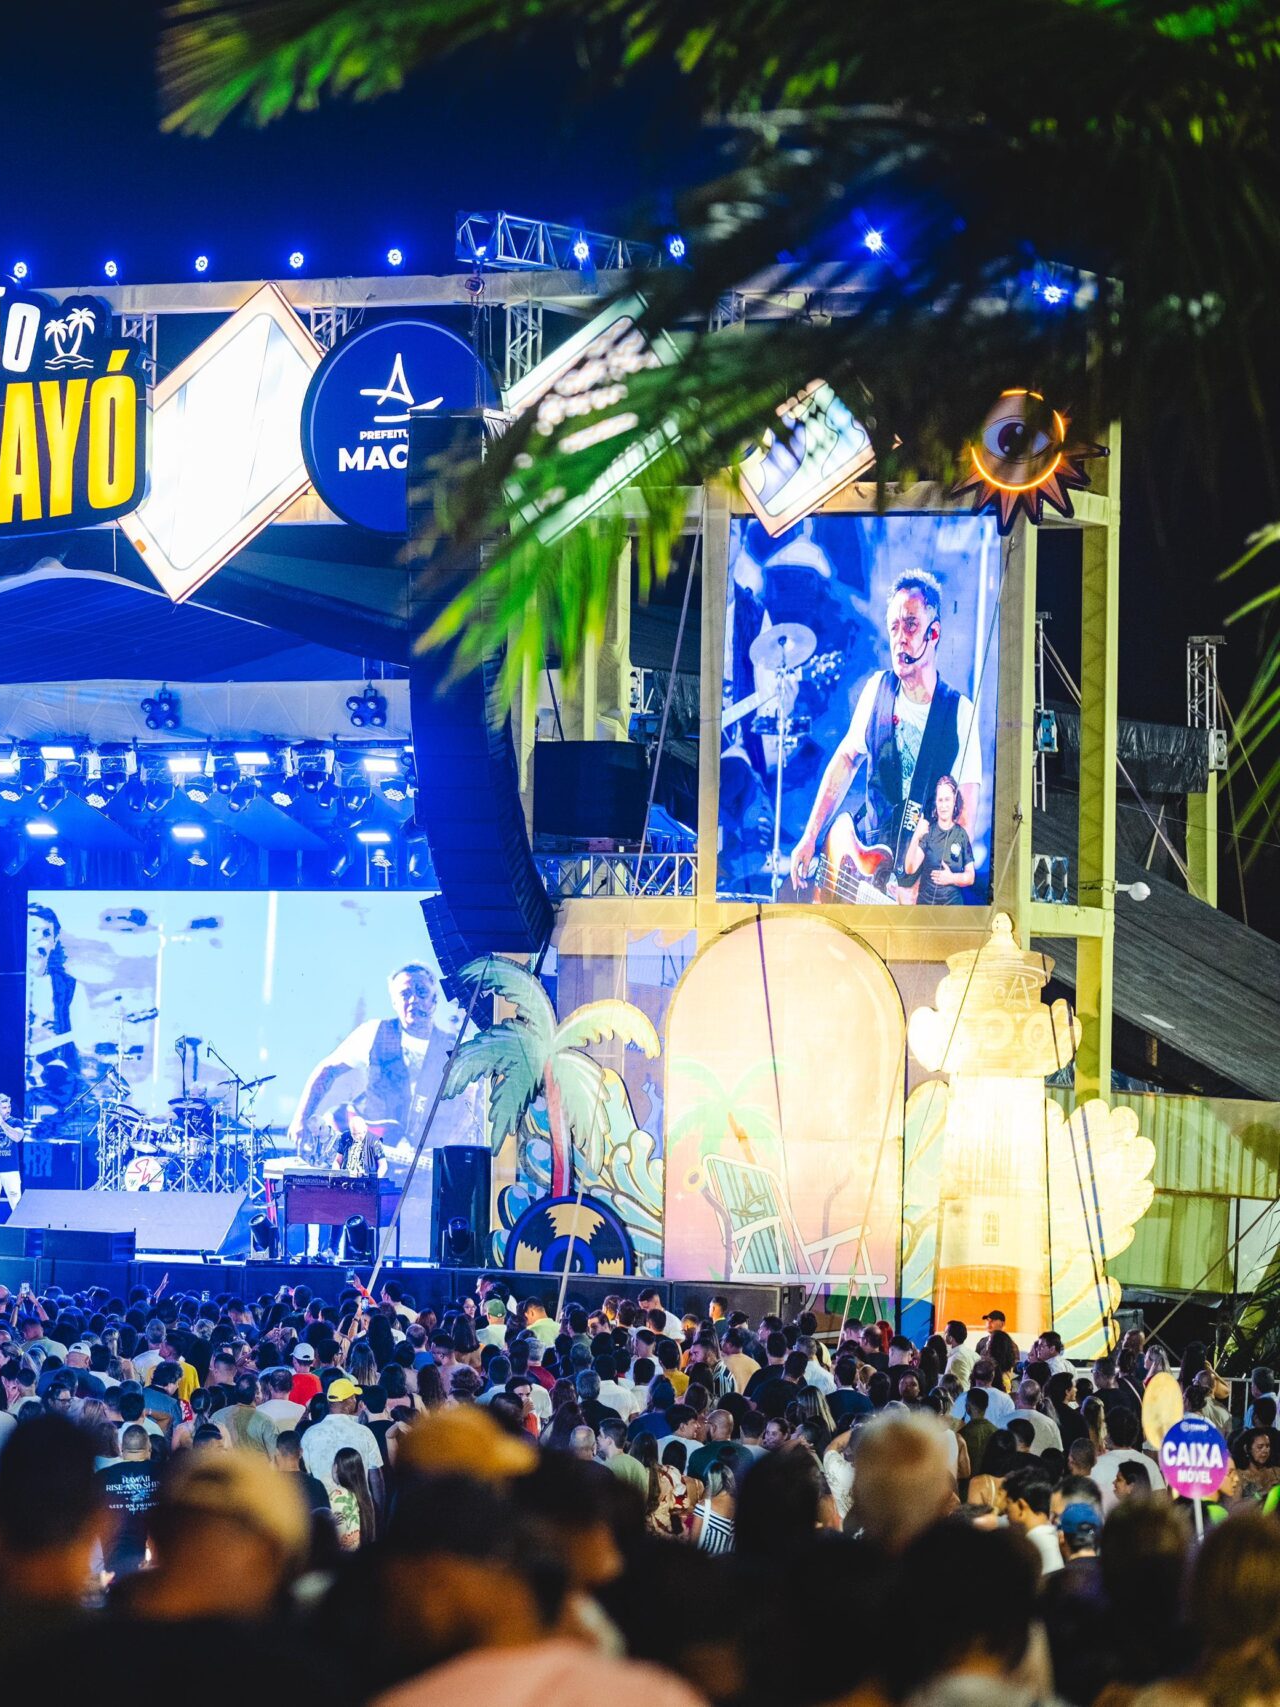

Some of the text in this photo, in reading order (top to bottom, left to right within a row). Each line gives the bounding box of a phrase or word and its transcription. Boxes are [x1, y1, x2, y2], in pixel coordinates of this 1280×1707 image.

[1163, 1441, 1223, 1468] CAIXA
[1177, 1467, 1212, 1484] MÓVEL
[106, 1484, 123, 1492] RISE
